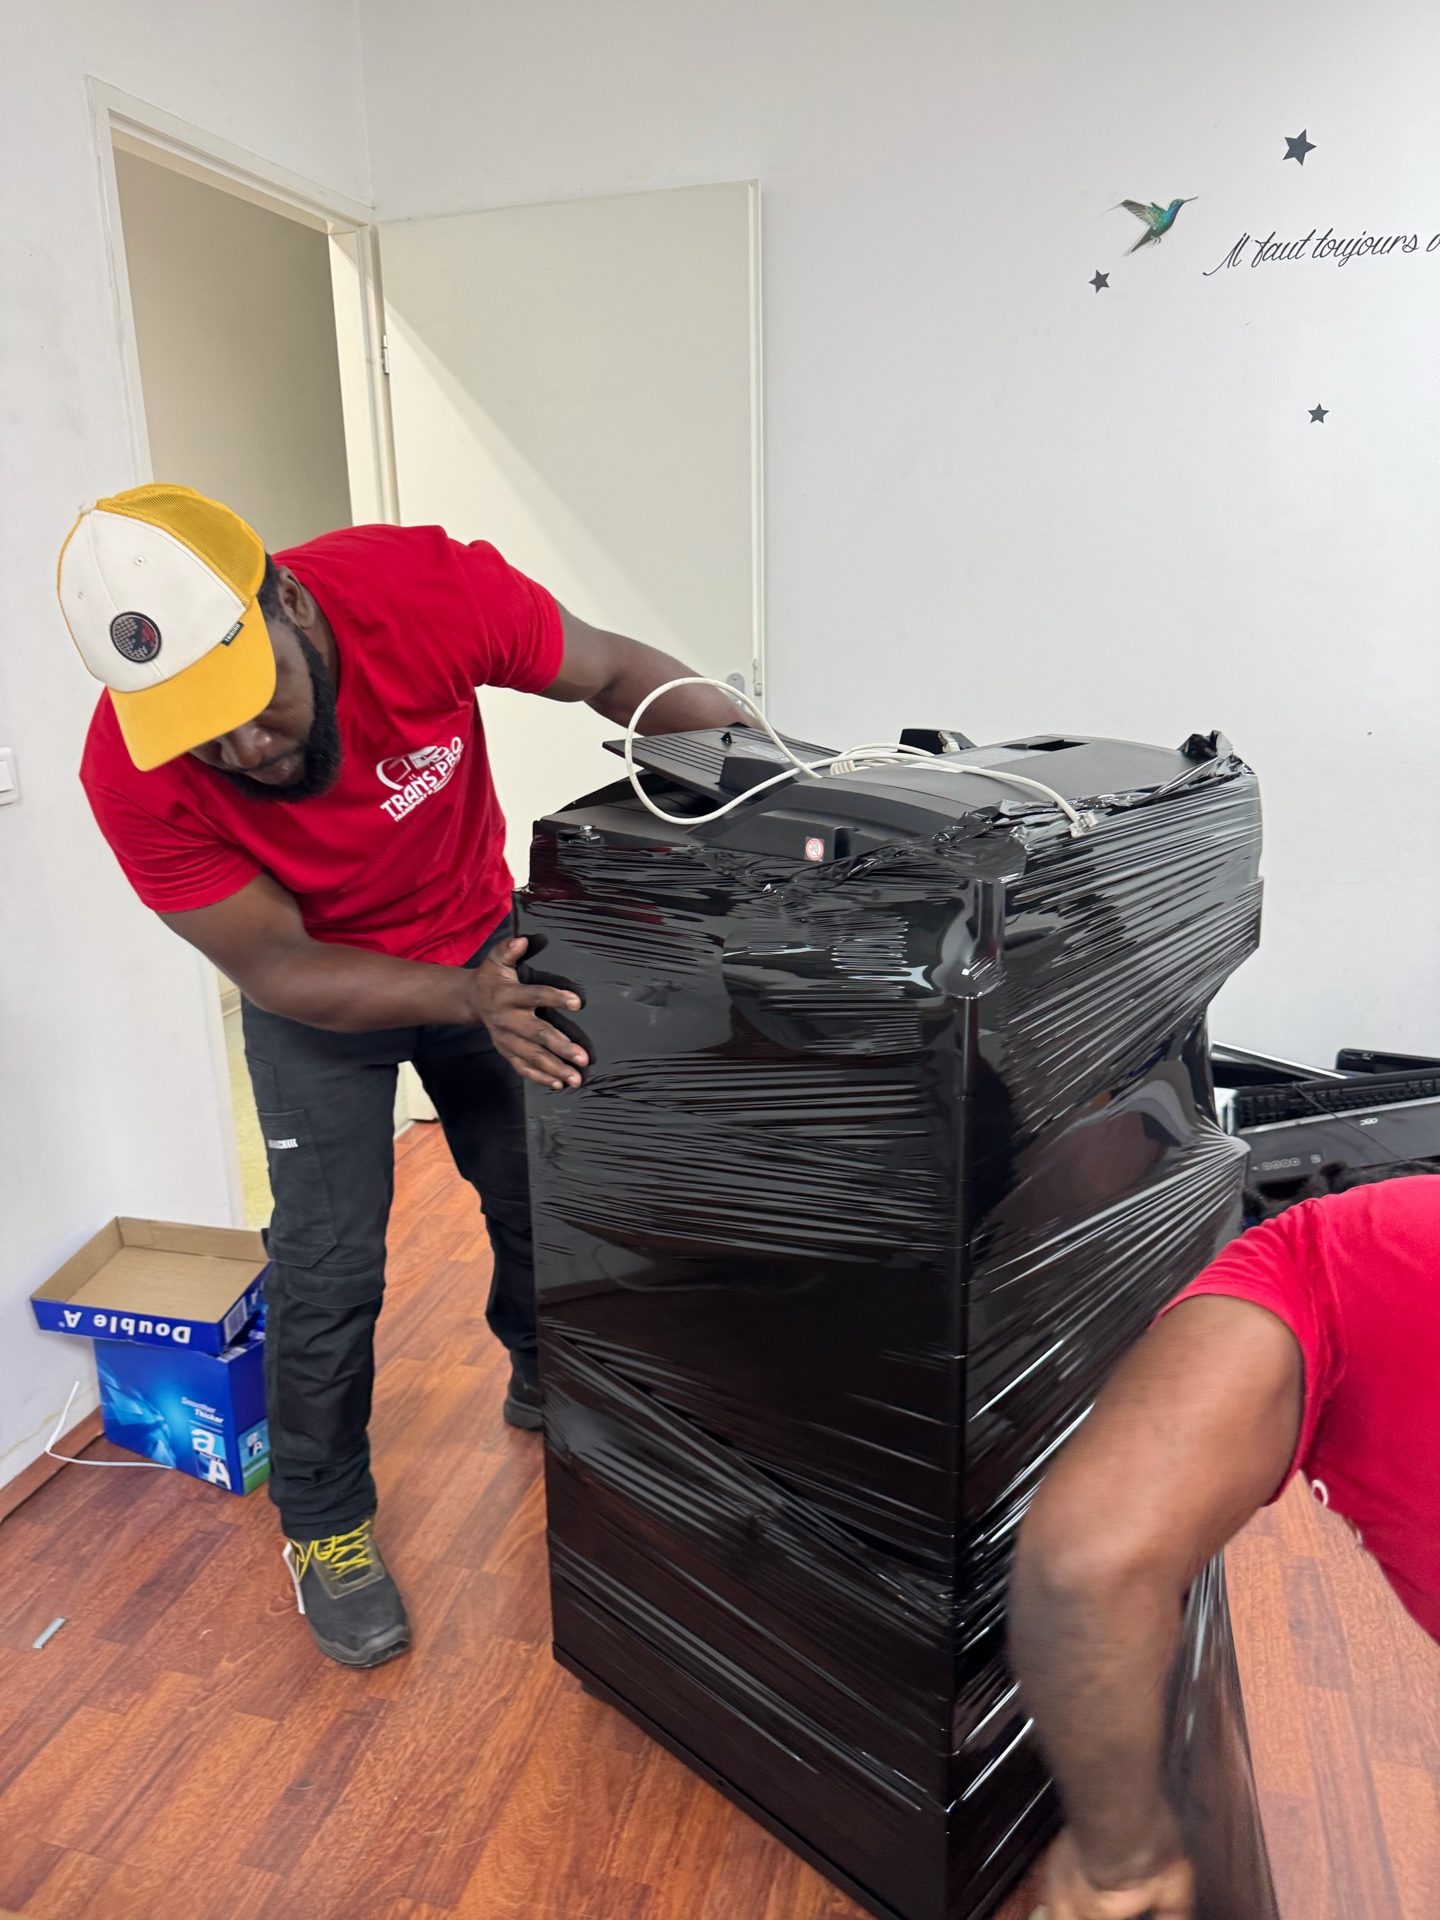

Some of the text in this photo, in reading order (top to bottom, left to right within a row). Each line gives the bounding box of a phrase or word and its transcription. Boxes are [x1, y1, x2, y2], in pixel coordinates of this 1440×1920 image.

[1251, 231, 1316, 268] faut
[1312, 228, 1419, 267] toujours
[93, 1313, 192, 1344] Double
